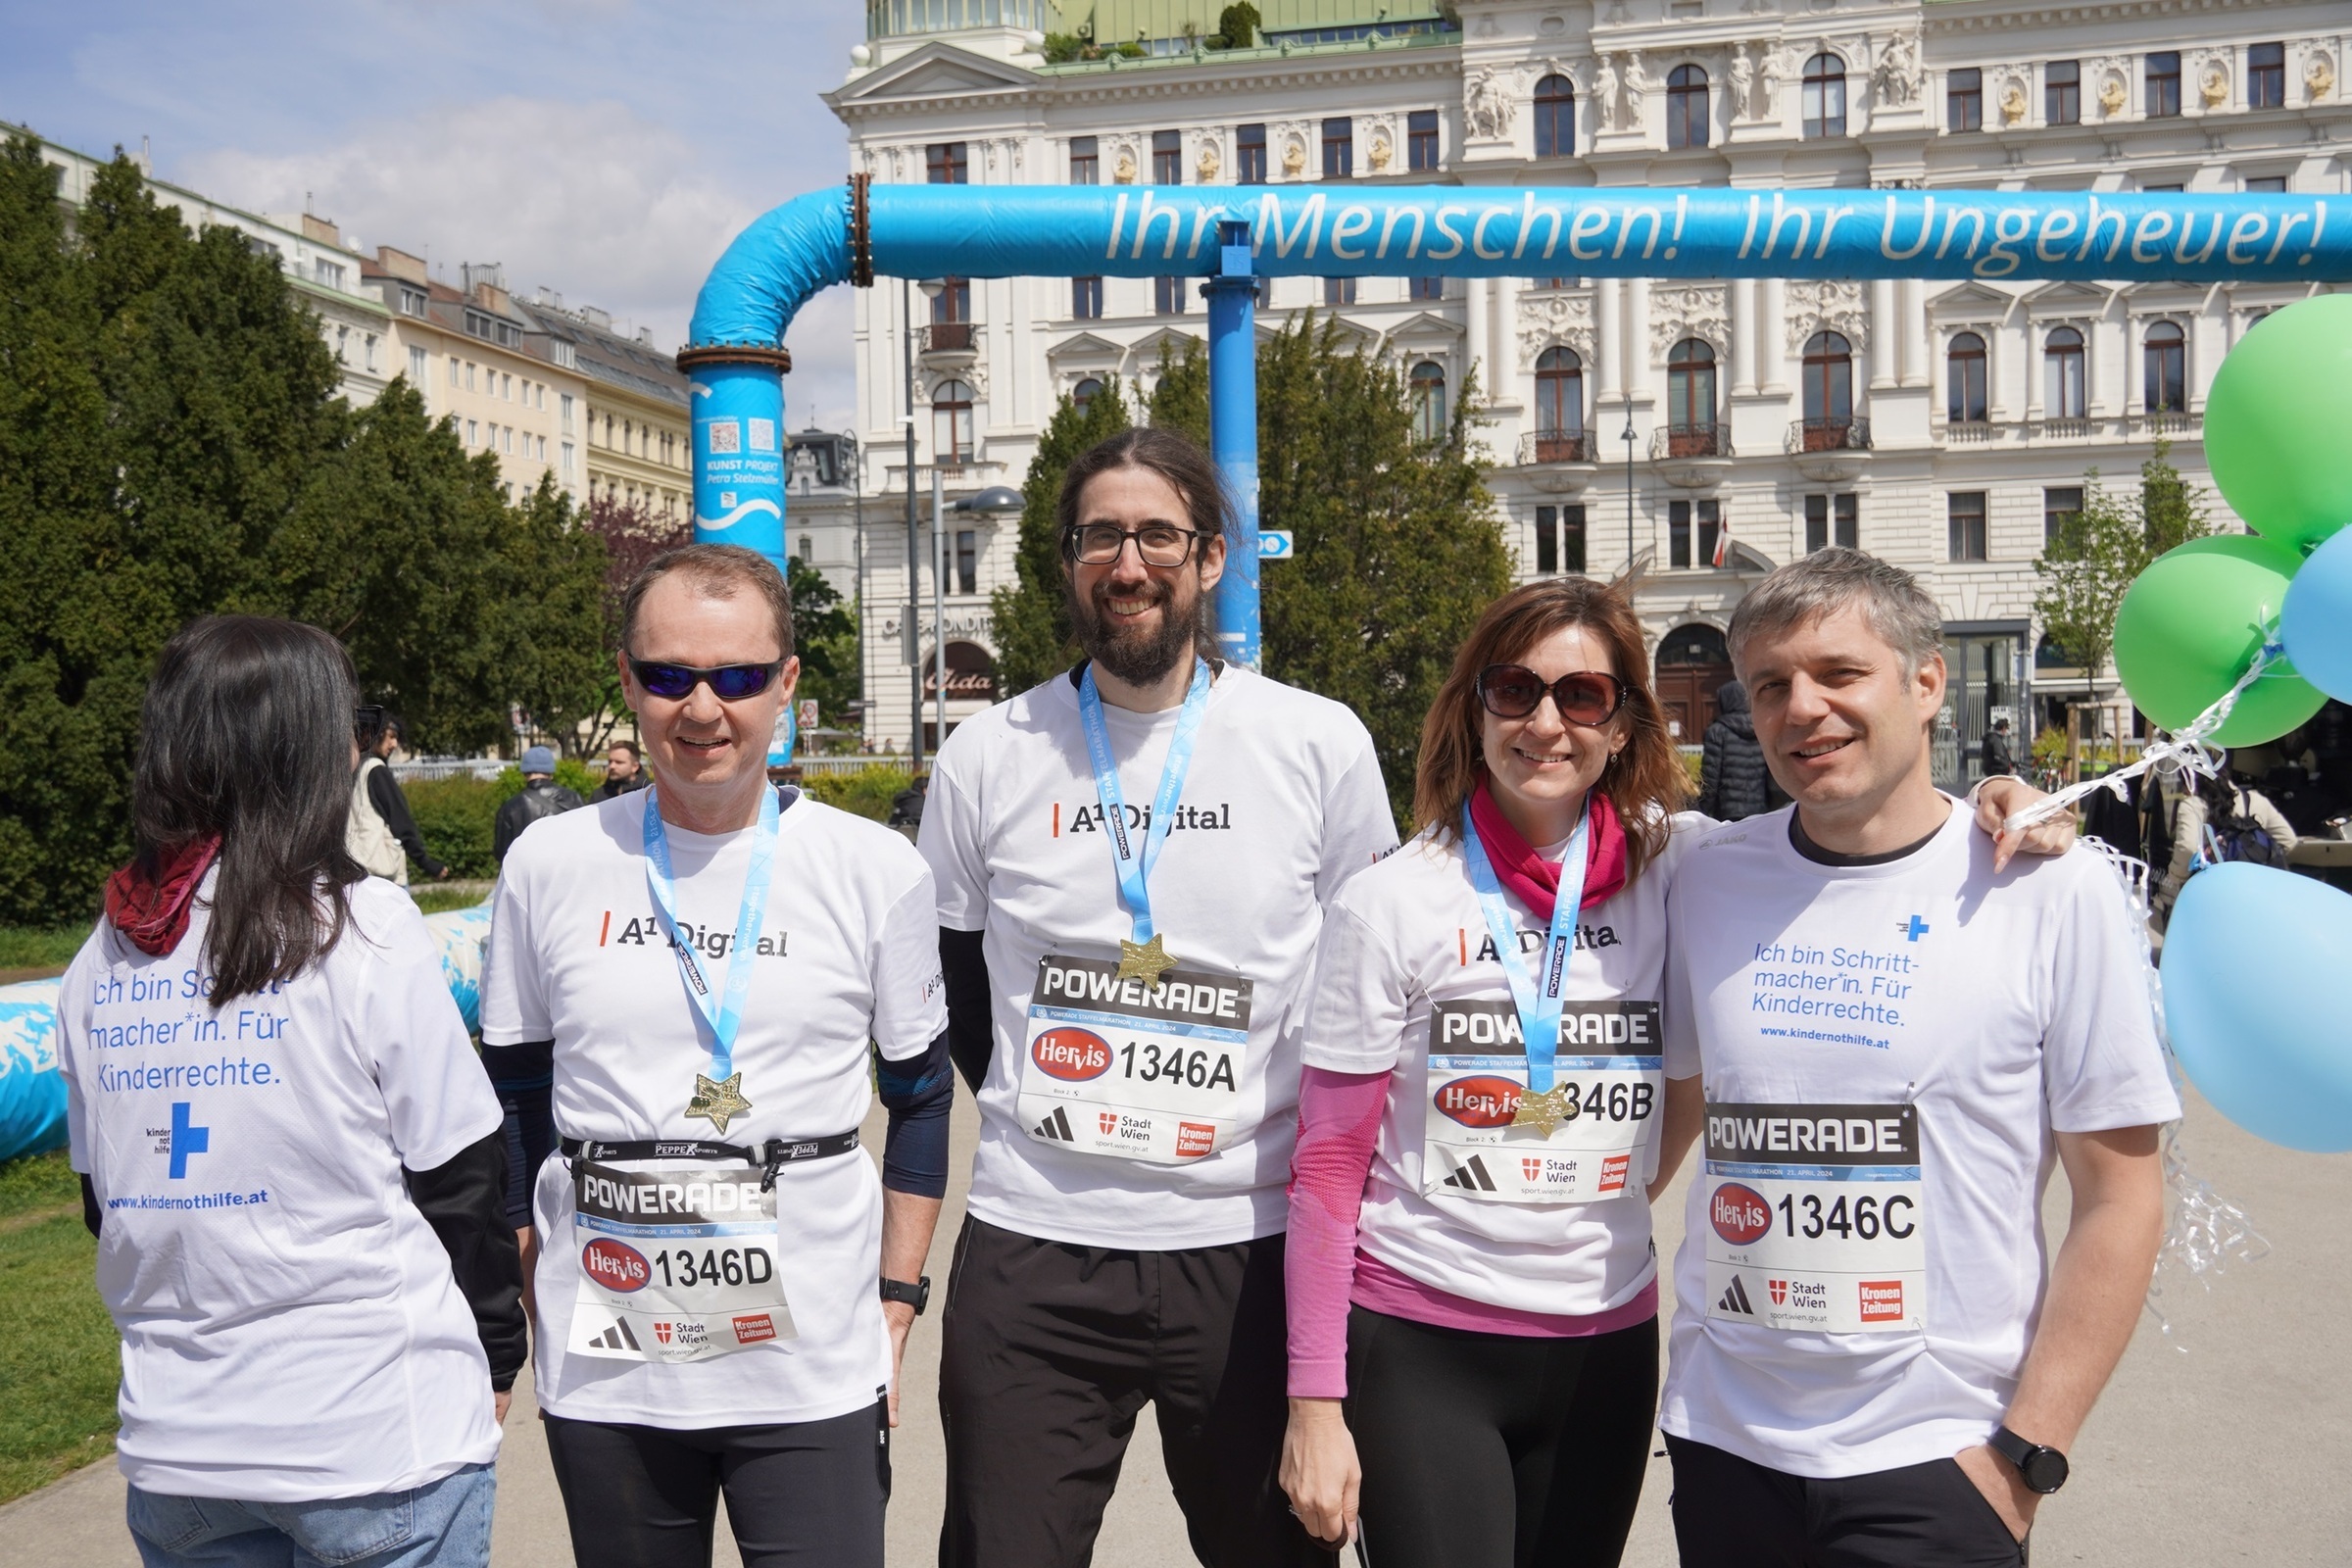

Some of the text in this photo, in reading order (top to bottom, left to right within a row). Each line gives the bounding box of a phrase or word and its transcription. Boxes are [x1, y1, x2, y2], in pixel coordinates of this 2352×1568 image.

[1106, 191, 2328, 277] Ihr Menschen! Ihr Ungeheuer!
[707, 460, 778, 473] KUNST PROJEKT
[707, 474, 731, 484] Petra
[1125, 804, 1231, 838] Diital
[1111, 806, 1130, 859] POWERADE
[617, 915, 788, 959] A1 Digal
[677, 944, 707, 995] POWERADE
[1549, 939, 1565, 997] POWERADE
[1754, 943, 1919, 974] Ich bin Schritt-
[131, 973, 172, 1002] bin
[1043, 966, 1239, 1018] POWERADE
[1872, 976, 1912, 1000] Für
[1051, 1010, 1077, 1019] POWERADE
[1078, 1014, 1131, 1026] STAFFELMARATHON
[1752, 992, 1904, 1026] Kinderrechte.
[237, 1010, 289, 1040] Für
[1443, 1013, 1650, 1044] POWRADE
[1761, 1026, 1889, 1050] www.kindernothilfe.at
[1040, 1036, 1105, 1070] Hervis
[98, 1056, 280, 1093] Kinderrechte.
[1120, 1041, 1236, 1092] 1346A
[1446, 1087, 1521, 1118] Hervis
[1564, 1082, 1654, 1122] 346B
[146, 1128, 171, 1138] kinder
[1122, 1116, 1152, 1130] Stadt
[1180, 1126, 1212, 1141] Kronen
[1709, 1116, 1902, 1152] POWERADE
[1095, 1140, 1149, 1152] sport.wien.gv.at
[1120, 1128, 1151, 1142] Wien
[1178, 1139, 1211, 1152] Zeitung
[154, 1145, 170, 1154] hilfe
[1547, 1159, 1577, 1171] Stadt
[1602, 1160, 1628, 1174] Kronen
[1546, 1171, 1576, 1183] Wien
[1600, 1172, 1626, 1186] Zeitung
[108, 1189, 269, 1209] www.kindernothilfe.at
[584, 1173, 761, 1214] POWERADE
[1521, 1187, 1575, 1196] sport.wien.gv.at
[1715, 1196, 1765, 1232] Hervis
[1778, 1194, 1915, 1240] 1346C
[589, 1246, 645, 1281] Hervis
[655, 1247, 772, 1287] 1346D
[1792, 1281, 1826, 1296] Stadt
[1861, 1286, 1900, 1300] Kronen
[1792, 1296, 1827, 1308] Wien
[1862, 1300, 1901, 1315] Zeitung
[676, 1322, 705, 1333] Stadt
[735, 1319, 770, 1330] Kronen
[1770, 1312, 1828, 1323] sport.wien.gv.at
[677, 1334, 708, 1344] Wien
[739, 1328, 773, 1339] Zeitung
